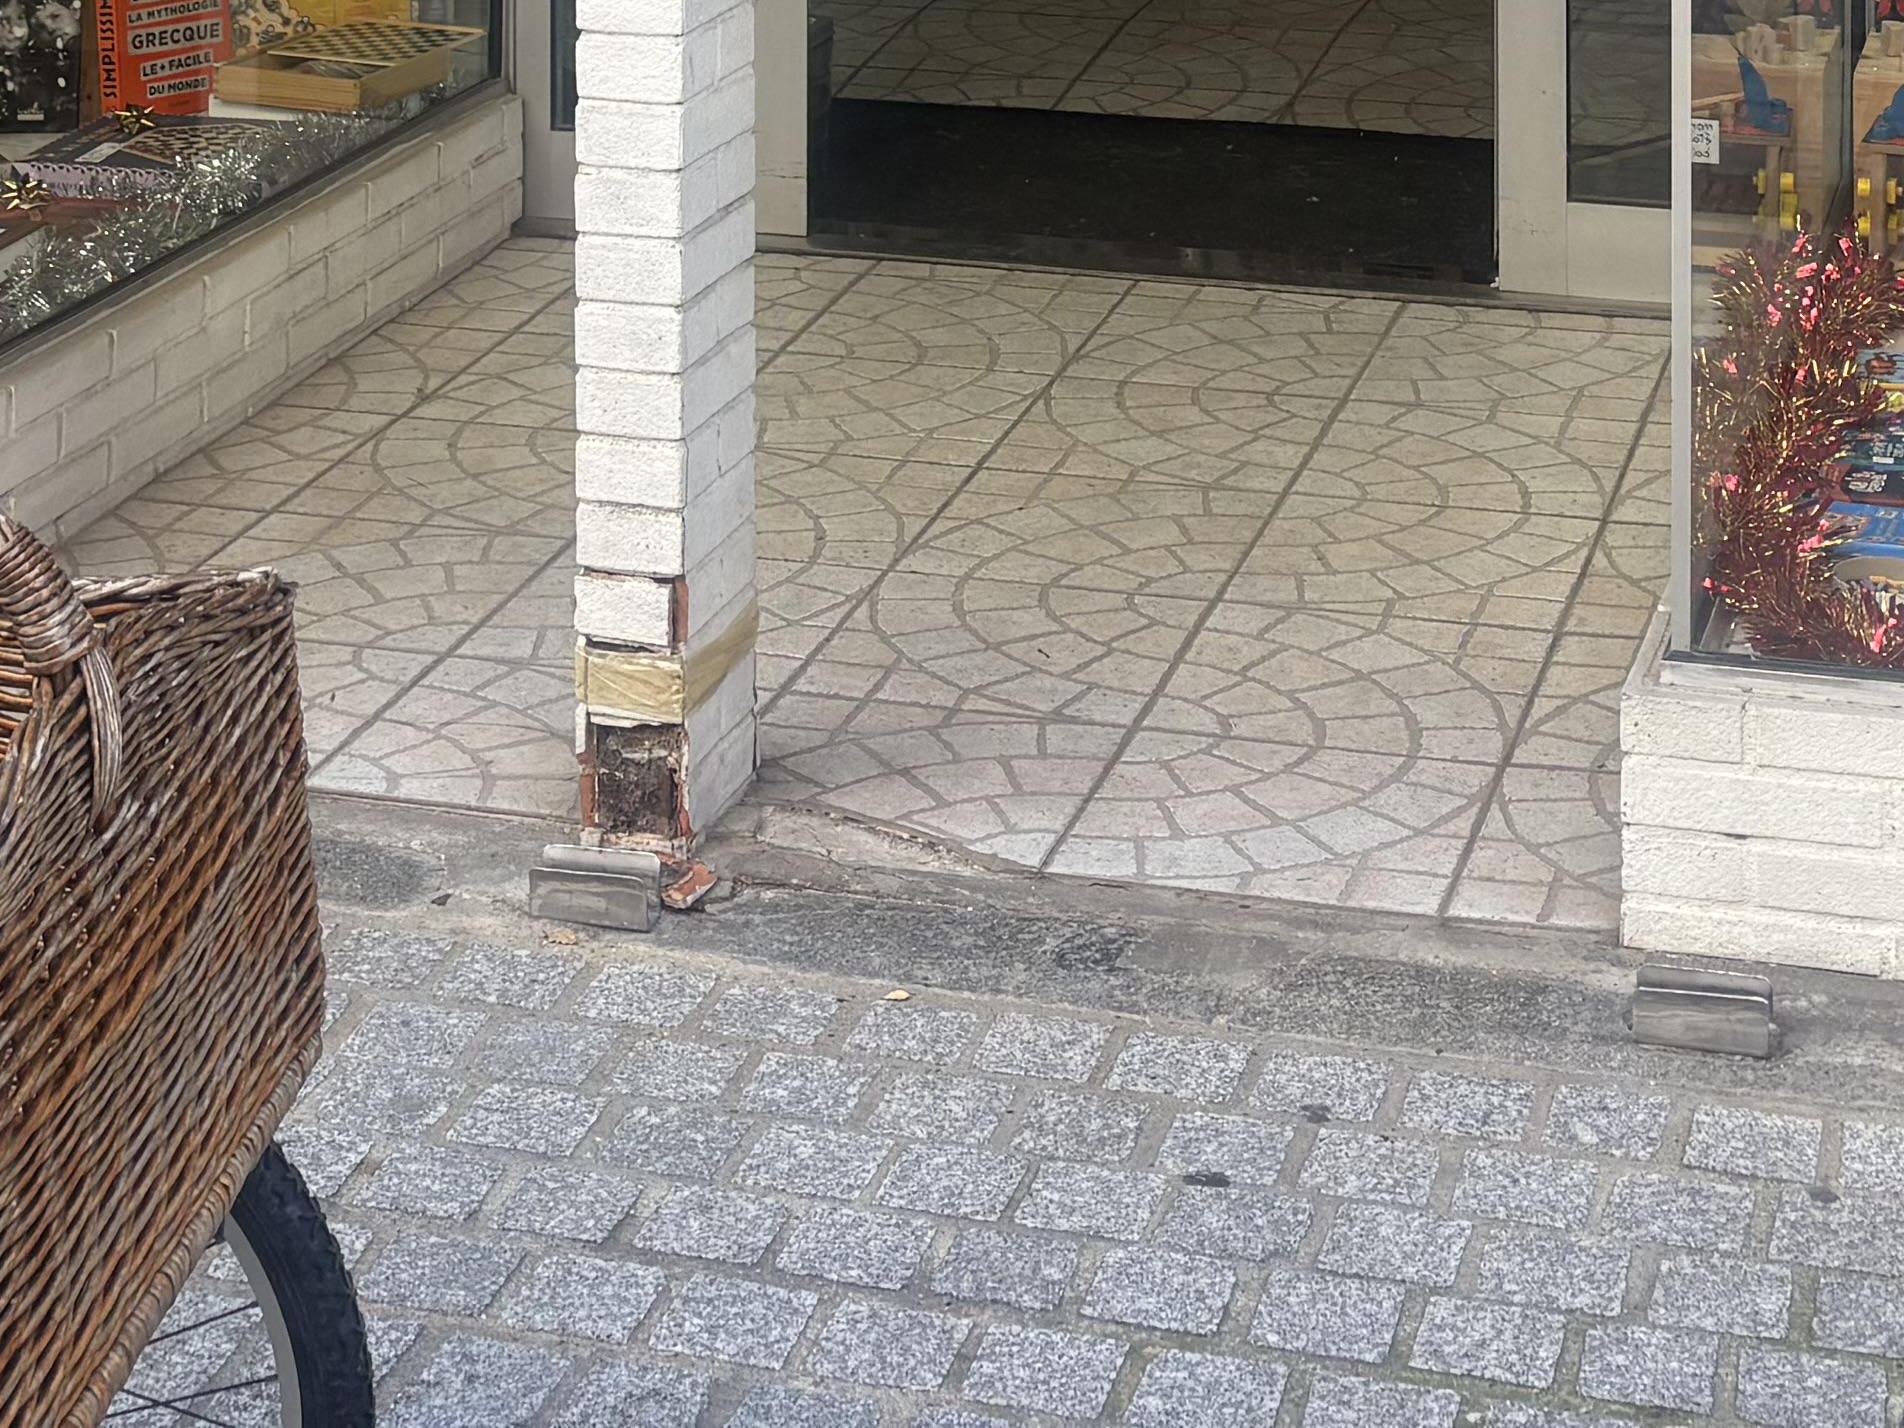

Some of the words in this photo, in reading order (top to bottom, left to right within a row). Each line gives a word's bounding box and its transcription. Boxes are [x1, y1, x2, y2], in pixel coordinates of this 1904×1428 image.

[128, 12, 143, 24] LA
[131, 22, 220, 50] GRECQUE
[142, 63, 158, 77] LE
[168, 51, 212, 71] FACILE
[148, 84, 165, 96] DU
[167, 78, 207, 93] MONDE
